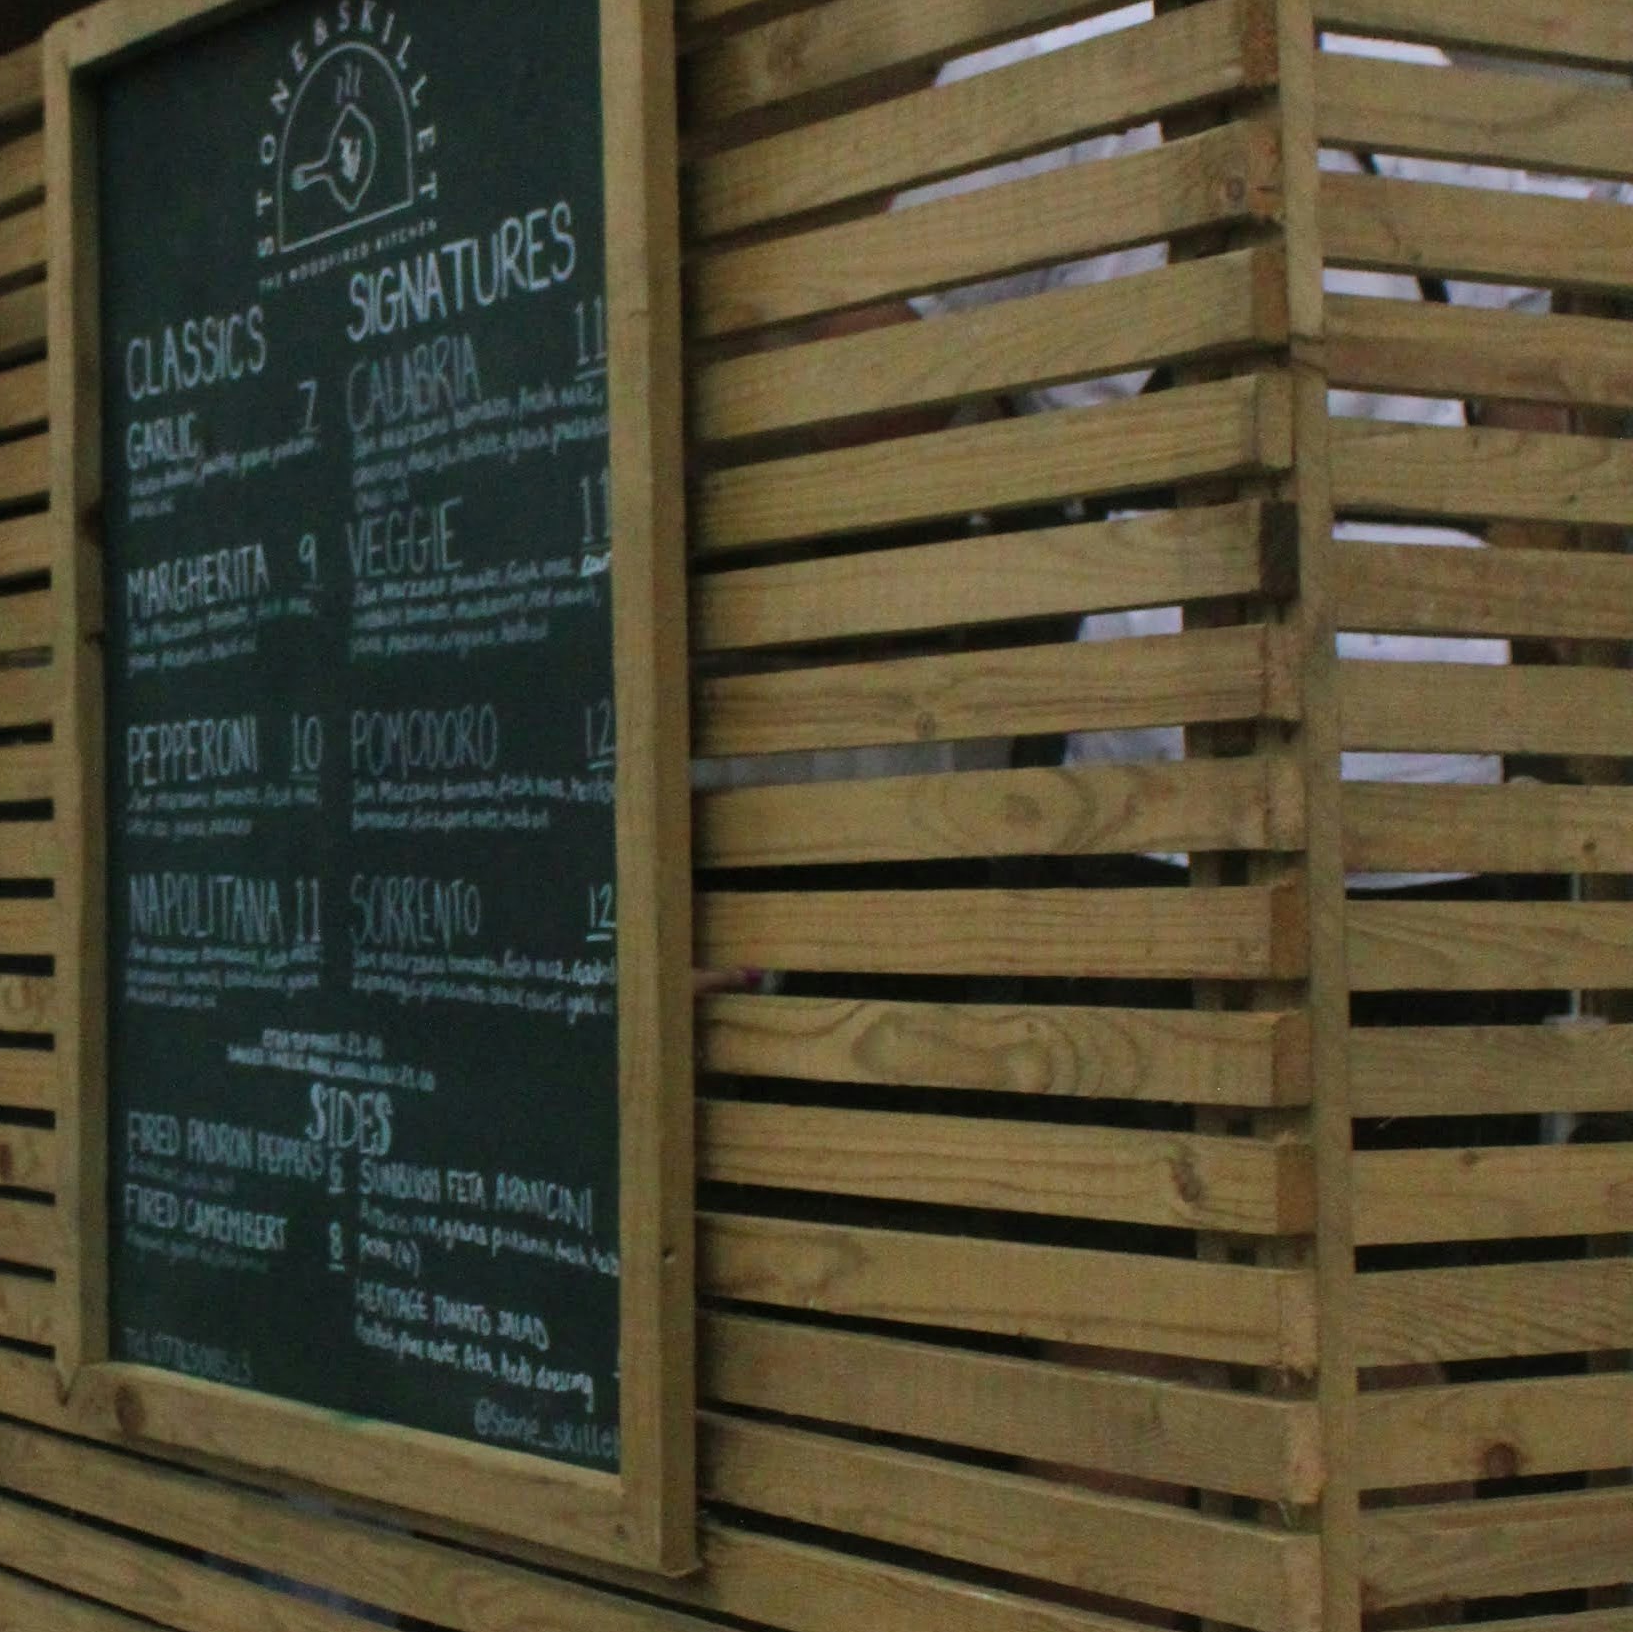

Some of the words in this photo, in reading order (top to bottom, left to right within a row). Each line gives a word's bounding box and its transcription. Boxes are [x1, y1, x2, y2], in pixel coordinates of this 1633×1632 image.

[346, 199, 577, 343] SIGNATURES
[125, 304, 268, 402] CLASSICS
[345, 332, 483, 435] CALABRIA
[574, 292, 609, 367] 11
[125, 410, 200, 472] GARLIC
[297, 377, 318, 433] 7
[125, 542, 270, 618] MARGHERITA
[298, 532, 317, 580] 9
[344, 495, 464, 578] VEGGIE
[126, 714, 259, 787] PEPPERONI
[290, 712, 323, 773] 10
[349, 700, 499, 779] POMODORO
[582, 697, 616, 760] 12
[128, 870, 285, 944] NAPOLITANA
[294, 876, 322, 944] 11
[348, 873, 482, 949] SORRENTO
[587, 883, 618, 930] 12
[126, 1109, 181, 1157] FIRED
[187, 1117, 253, 1169] PADRON
[257, 1131, 324, 1182] PEPPERS
[304, 1082, 394, 1157] SIDES
[123, 1182, 180, 1229] FIRED
[184, 1198, 289, 1251] CAMEMBERT
[328, 1221, 344, 1261] 8
[446, 1169, 486, 1204] FETA
[495, 1172, 593, 1235] ARANCINI
[355, 1278, 429, 1321] HERITAGE
[432, 1294, 492, 1336] TOMATO
[496, 1309, 551, 1352] SALAD
